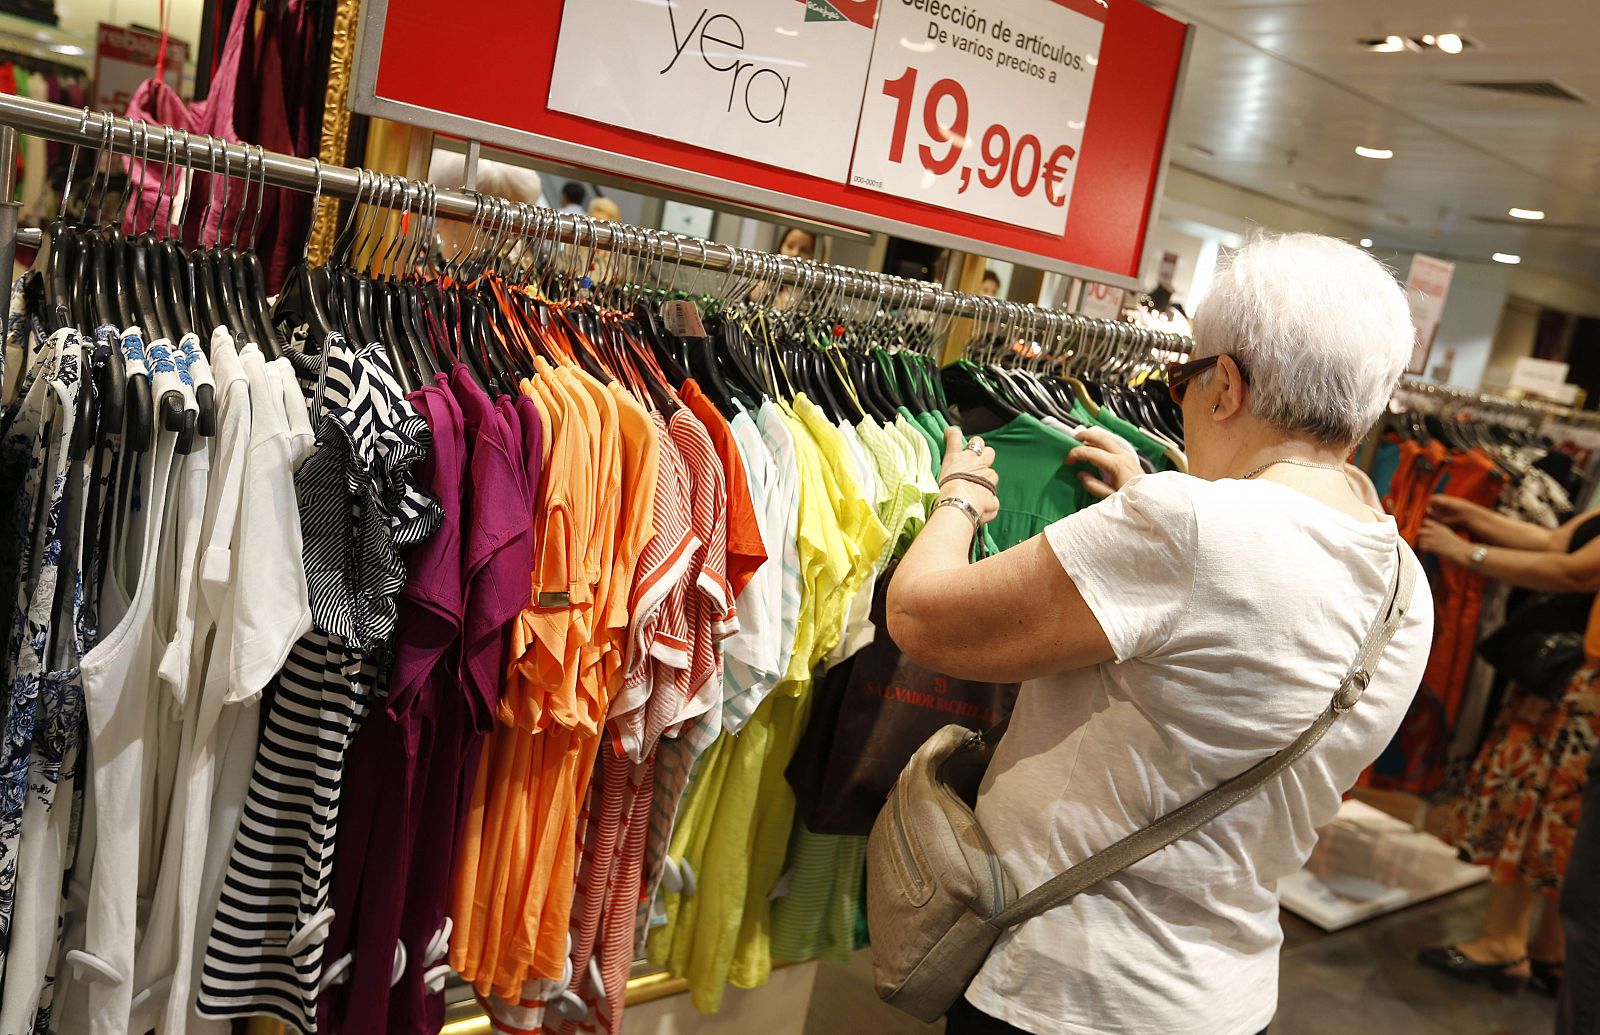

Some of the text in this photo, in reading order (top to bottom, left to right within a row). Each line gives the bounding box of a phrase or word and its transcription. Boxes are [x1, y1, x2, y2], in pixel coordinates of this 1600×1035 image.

[660, 0, 790, 127] yera
[927, 21, 1057, 84] De varios precios a
[991, 21, 1012, 43] de
[1015, 32, 1084, 72] artículos.
[882, 66, 1076, 207] 19,90€
